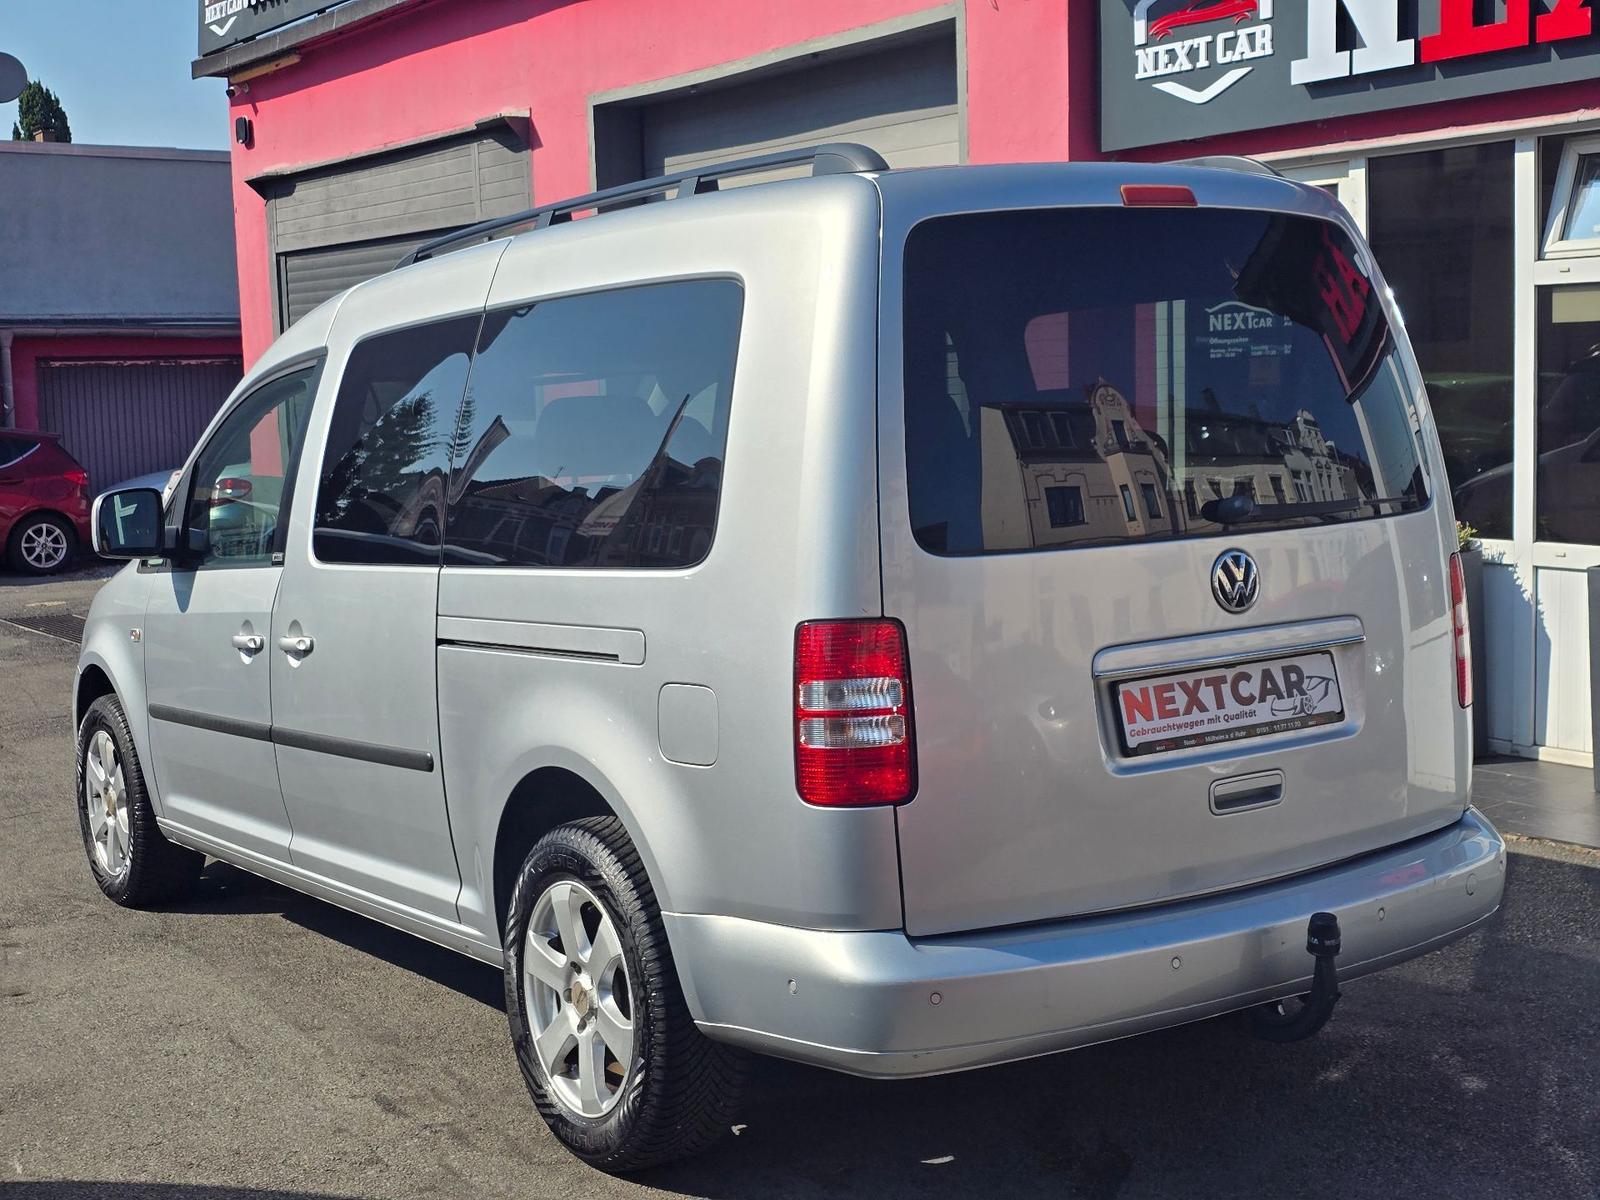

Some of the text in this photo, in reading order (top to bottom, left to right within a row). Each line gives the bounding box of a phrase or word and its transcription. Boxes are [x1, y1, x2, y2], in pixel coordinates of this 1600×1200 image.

[204, 1, 227, 24] NEXT
[1135, 24, 1274, 80] NEXT CAR
[1122, 665, 1308, 725] NEXTCAR
[1129, 709, 1257, 738] Gebrauchtwagen mit Qualität
